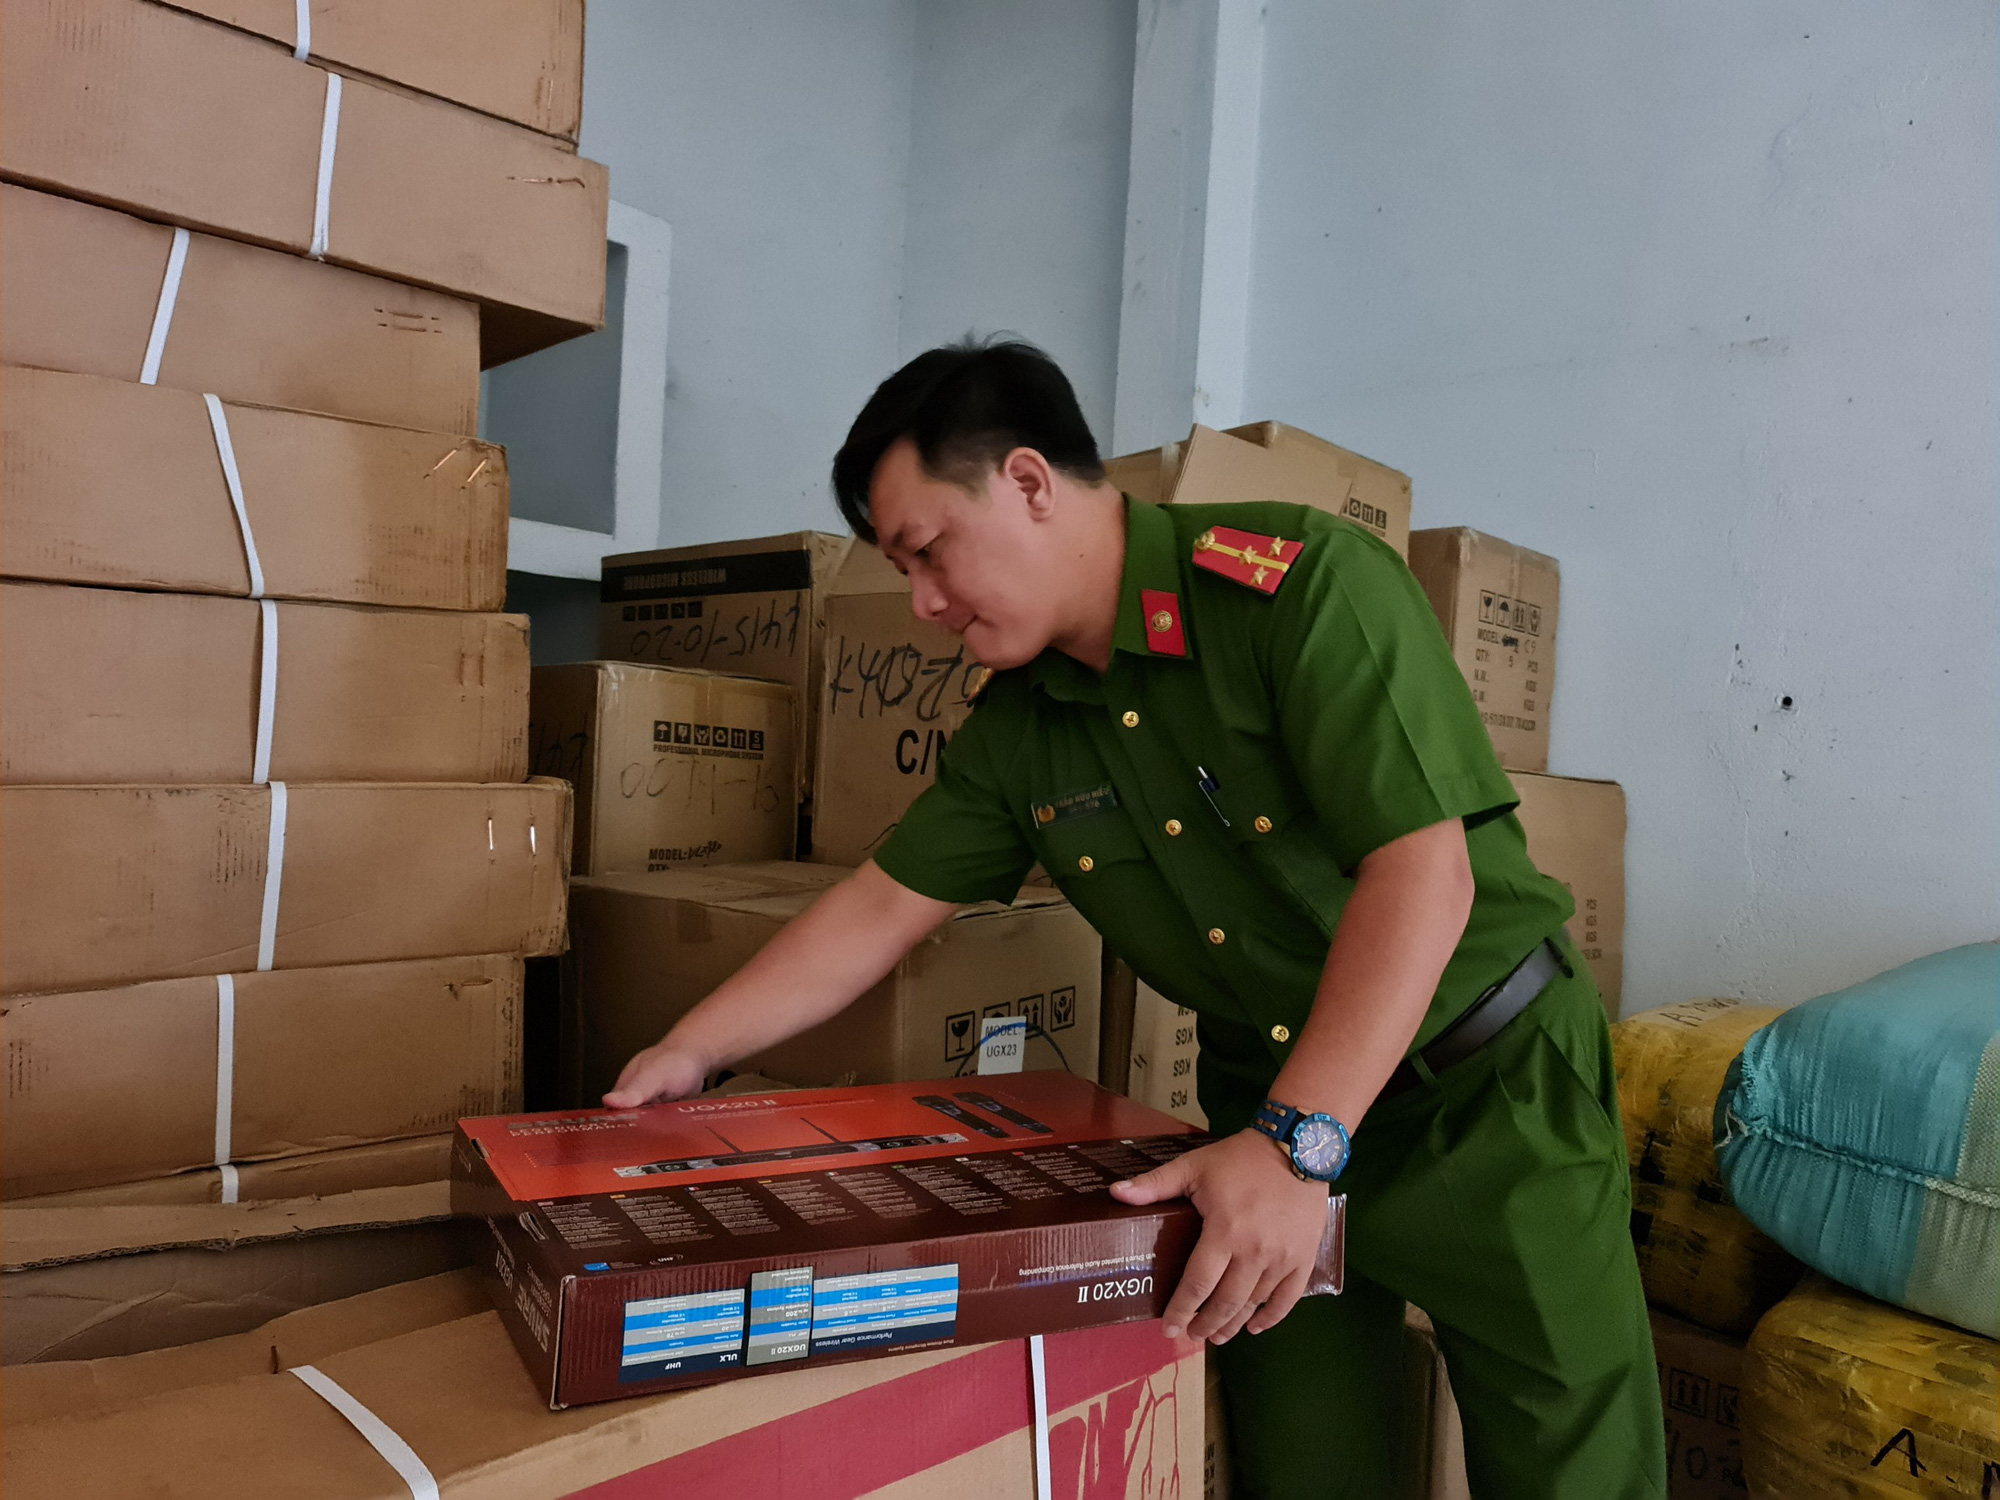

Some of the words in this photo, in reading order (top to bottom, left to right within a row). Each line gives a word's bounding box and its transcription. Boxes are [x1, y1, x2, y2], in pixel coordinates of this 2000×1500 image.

[653, 743, 699, 755] PROFESSIONAL
[701, 748, 741, 759] MICROPHONE
[649, 848, 686, 861] MODEL:
[985, 1024, 1021, 1037] MODEL:
[1175, 1027, 1193, 1046] KGS
[986, 1044, 1017, 1057] UGX23
[1173, 1058, 1191, 1077] KGS
[1171, 1089, 1187, 1109] PCS
[677, 1101, 758, 1113] UGX20
[1056, 1262, 1084, 1271] Reference
[1102, 1256, 1124, 1266] patented
[1019, 1265, 1055, 1276] Companding
[1093, 1276, 1153, 1301] UGX20
[841, 1336, 856, 1344] Gear
[857, 1332, 892, 1341] Performance
[777, 1343, 806, 1353] UGX20
[815, 1338, 840, 1348] Wireless
[720, 1354, 737, 1362] ULX
[665, 1362, 681, 1370] UHF
